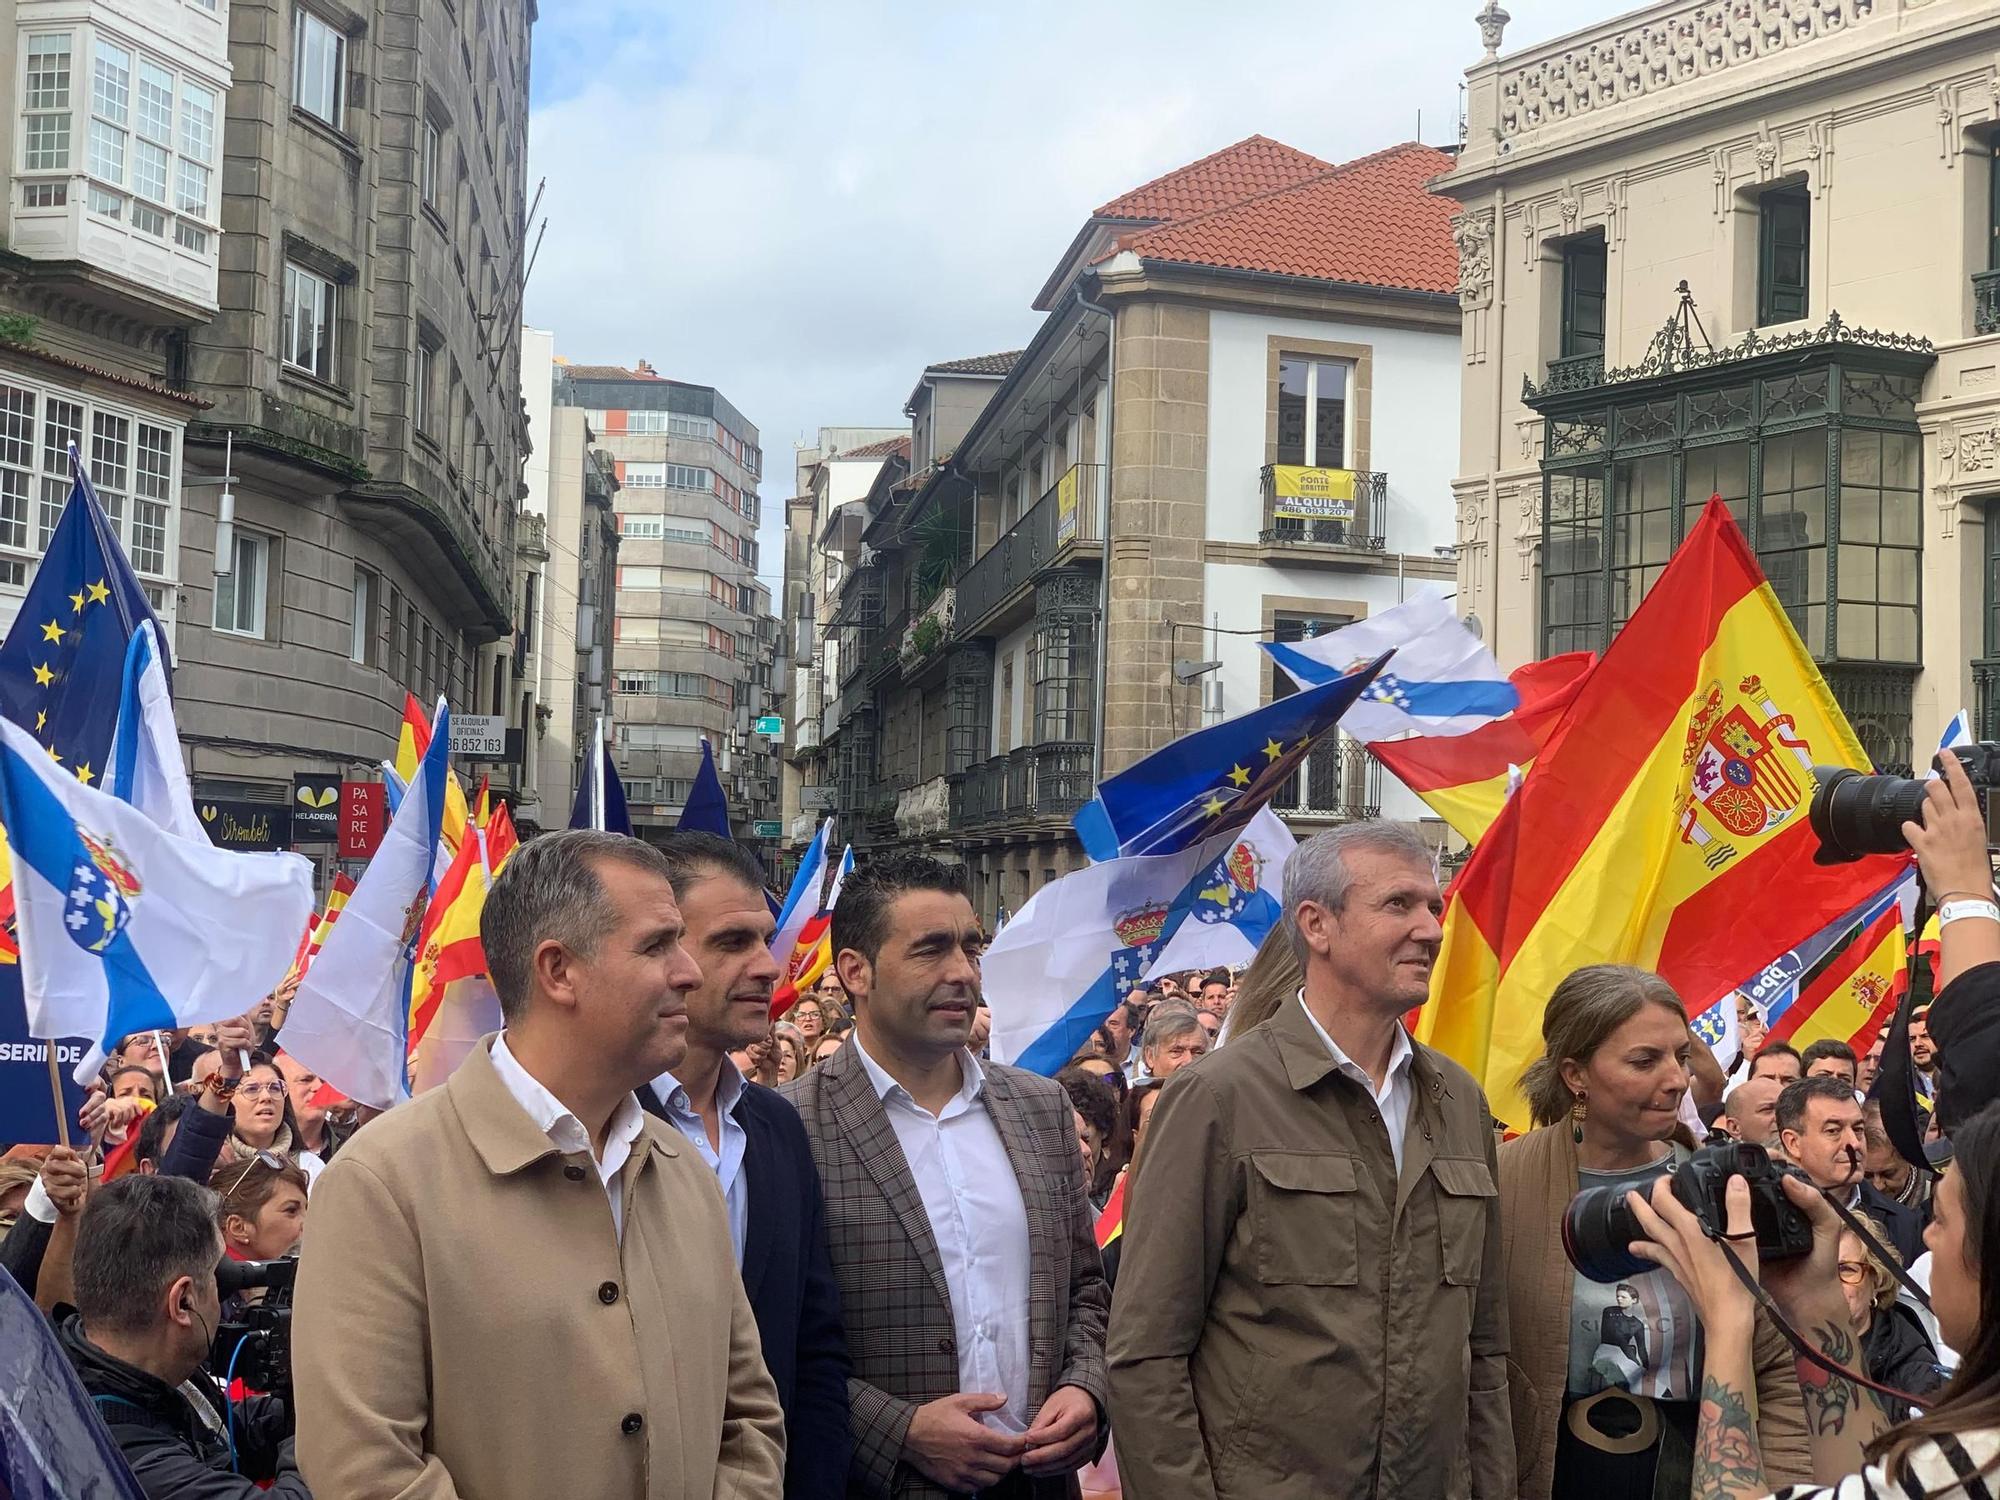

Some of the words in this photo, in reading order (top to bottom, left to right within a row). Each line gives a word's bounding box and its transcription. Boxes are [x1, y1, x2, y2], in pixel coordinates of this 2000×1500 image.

[1285, 496, 1346, 508] ALQUILA
[1281, 506, 1302, 514] 886
[451, 717, 459, 725] SE
[461, 717, 490, 726] ALQUILAN
[456, 727, 485, 736] OFICINAS
[461, 738, 481, 751] 852
[484, 739, 501, 752] 163
[221, 813, 271, 842] Stromboli
